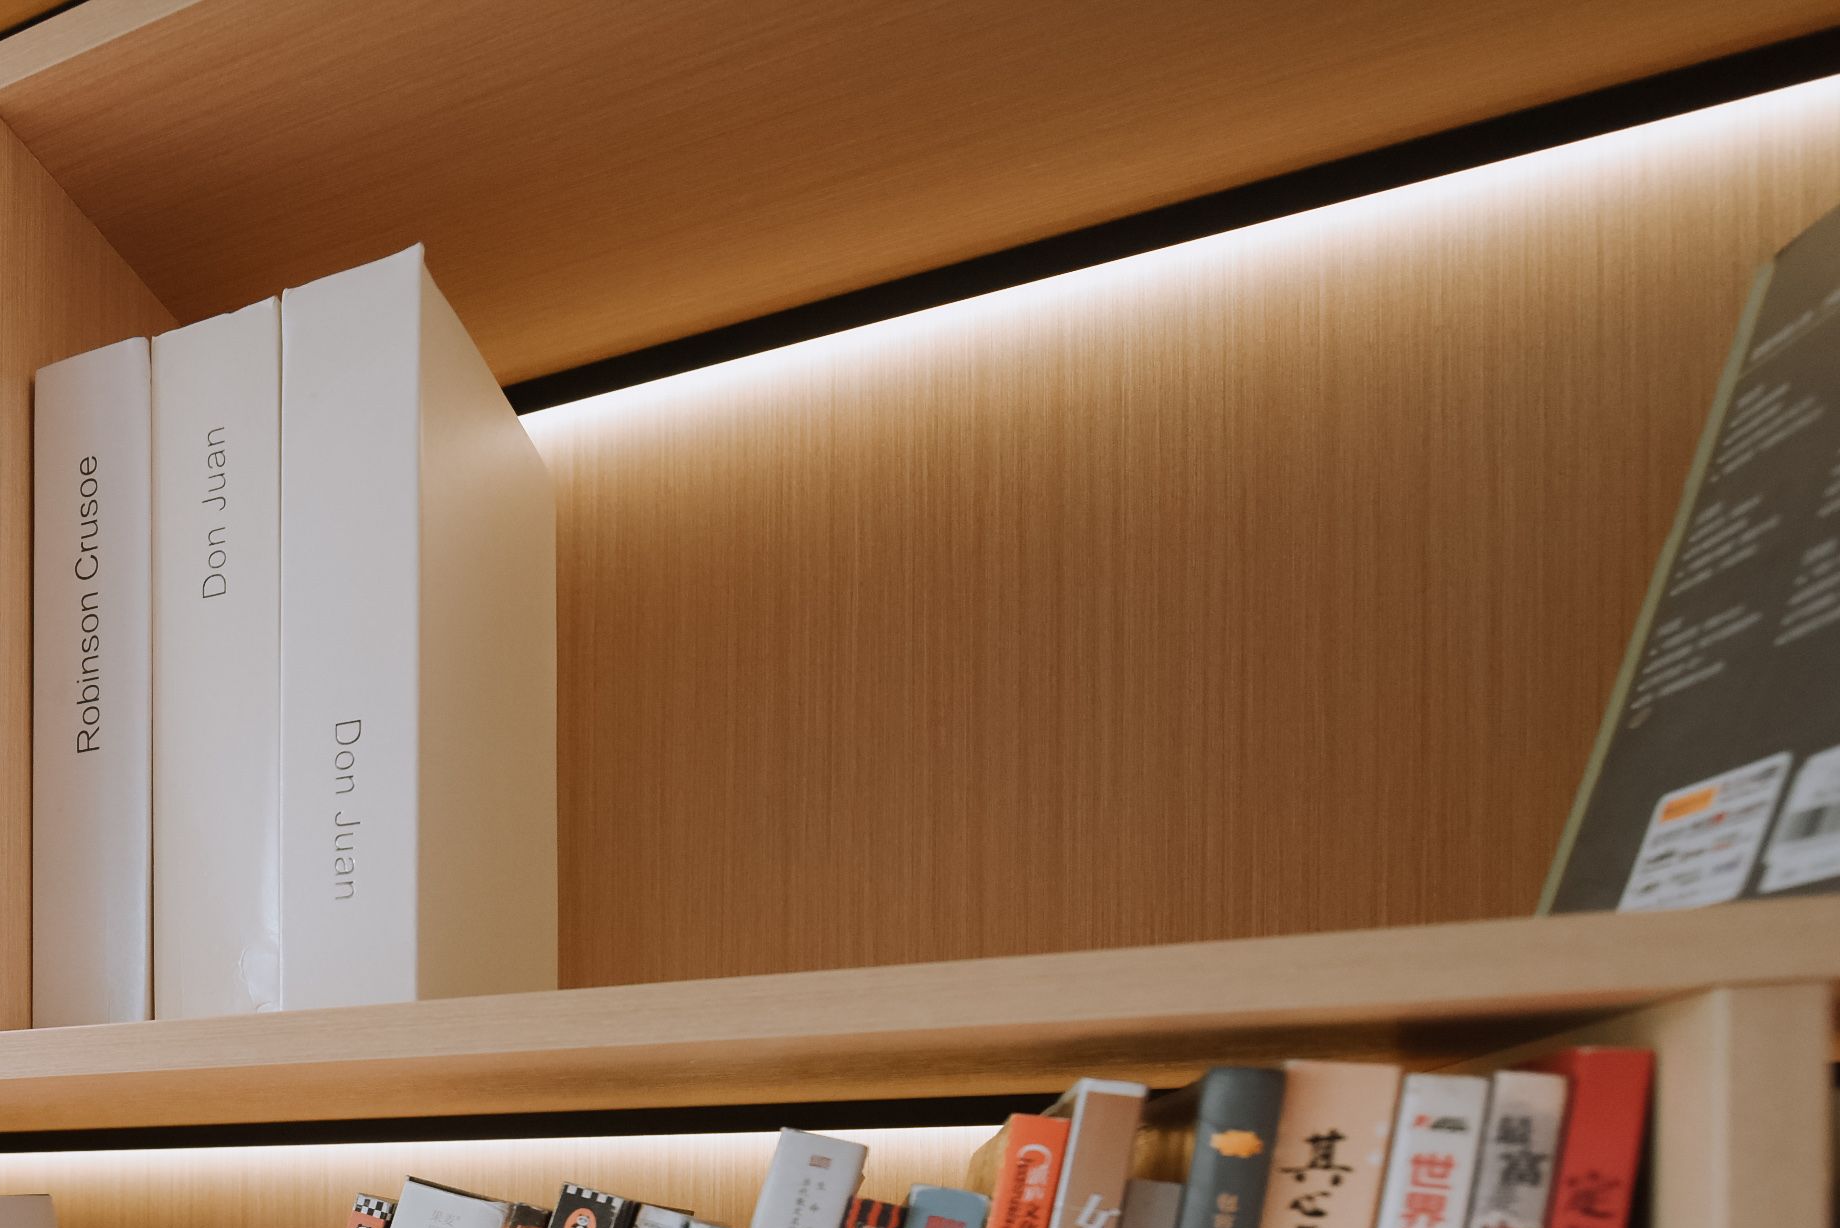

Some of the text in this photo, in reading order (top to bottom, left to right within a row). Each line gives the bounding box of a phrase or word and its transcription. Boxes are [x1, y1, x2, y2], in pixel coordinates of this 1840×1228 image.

[202, 425, 227, 599] Don Juan
[74, 455, 100, 753] Robinson Crusoe
[334, 719, 361, 900] Don Juan
